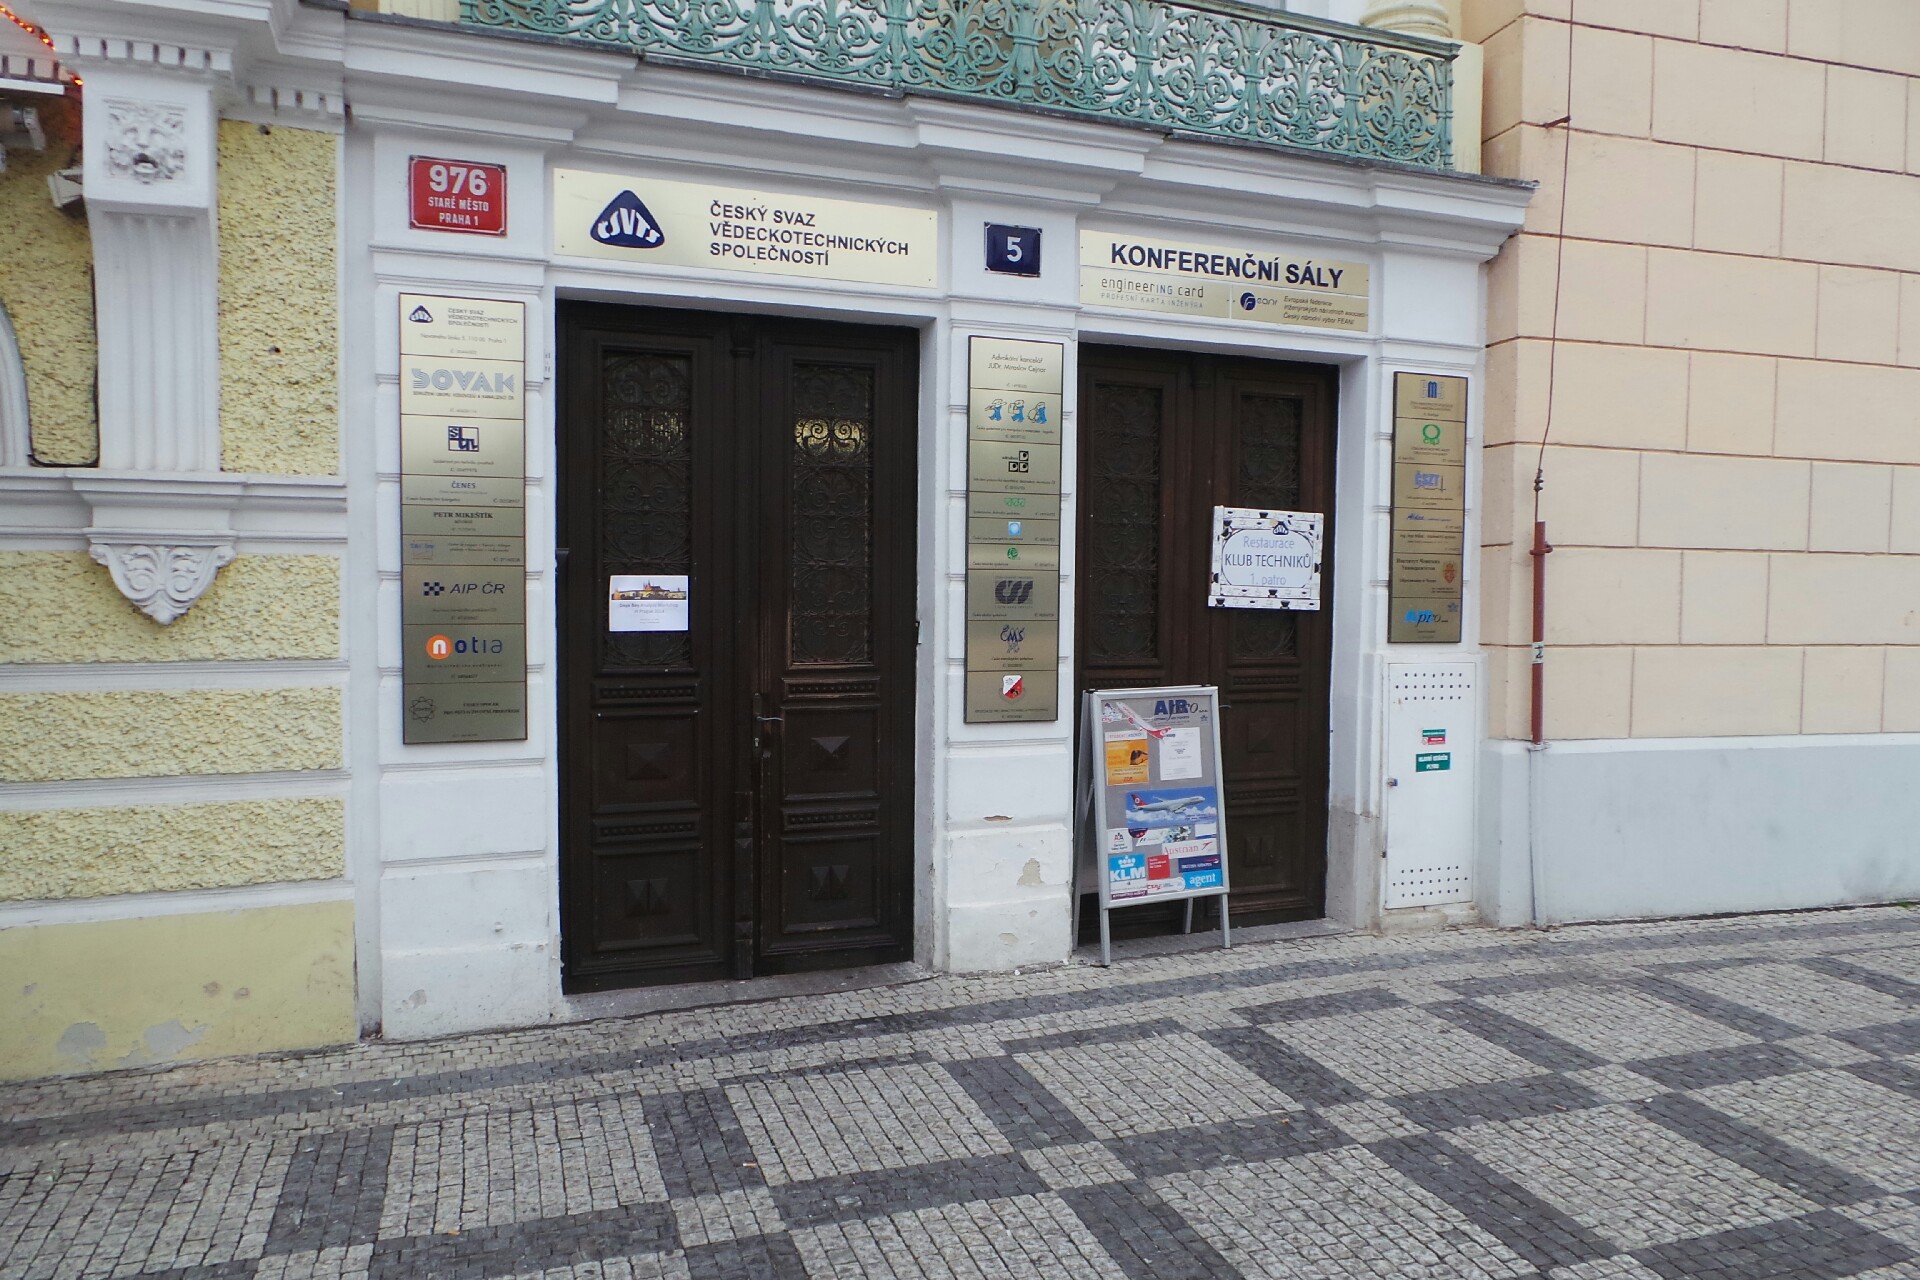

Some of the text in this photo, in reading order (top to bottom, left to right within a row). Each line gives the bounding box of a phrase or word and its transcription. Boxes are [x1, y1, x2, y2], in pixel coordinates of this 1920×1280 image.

[429, 164, 488, 196] 976
[428, 196, 489, 212] STARÉ MĚSTO
[439, 212, 479, 226] PRAHA 1
[710, 200, 816, 228] ČESKÝ SVAZ
[709, 222, 909, 256] VĚDECKOTECHNICKÝCH
[709, 243, 829, 266] SPOLEČNOSTÍ
[1006, 235, 1023, 263] 5
[1110, 242, 1344, 289] KONFERENČNÍ SÁLY
[1177, 285, 1204, 298] card
[1140, 297, 1166, 305] KARTA
[451, 480, 476, 489] ČENES
[1243, 535, 1295, 549] Restaurace
[1224, 553, 1312, 569] KLUB TECHNIKŮ
[449, 581, 506, 595] AIP ČR
[1261, 575, 1287, 586] patro
[432, 636, 503, 654] notia
[1162, 844, 1200, 857] Austrian
[1109, 866, 1147, 882] KLM
[1189, 873, 1217, 888] agent
